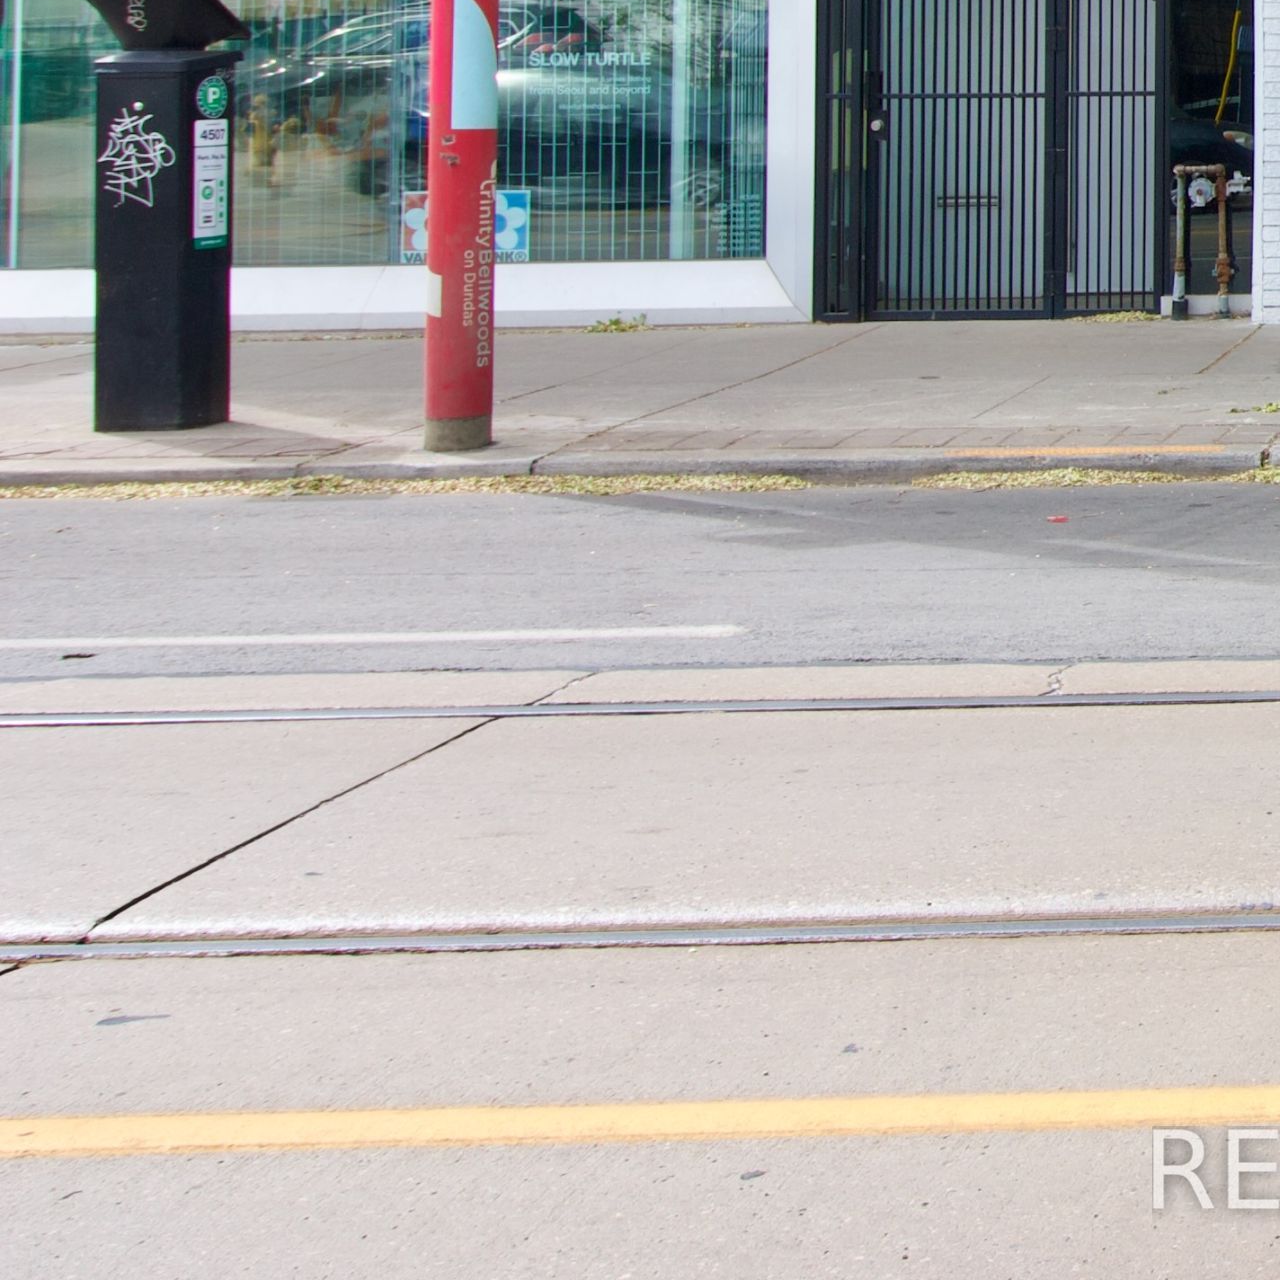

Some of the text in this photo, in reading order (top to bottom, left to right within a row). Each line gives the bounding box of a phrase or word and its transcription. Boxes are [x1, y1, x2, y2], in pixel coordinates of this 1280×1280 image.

[528, 52, 651, 67] SLOW TURTLE
[529, 84, 651, 97] from Seoul and beyond
[200, 128, 226, 141] 4507
[463, 250, 476, 327] on Dundas
